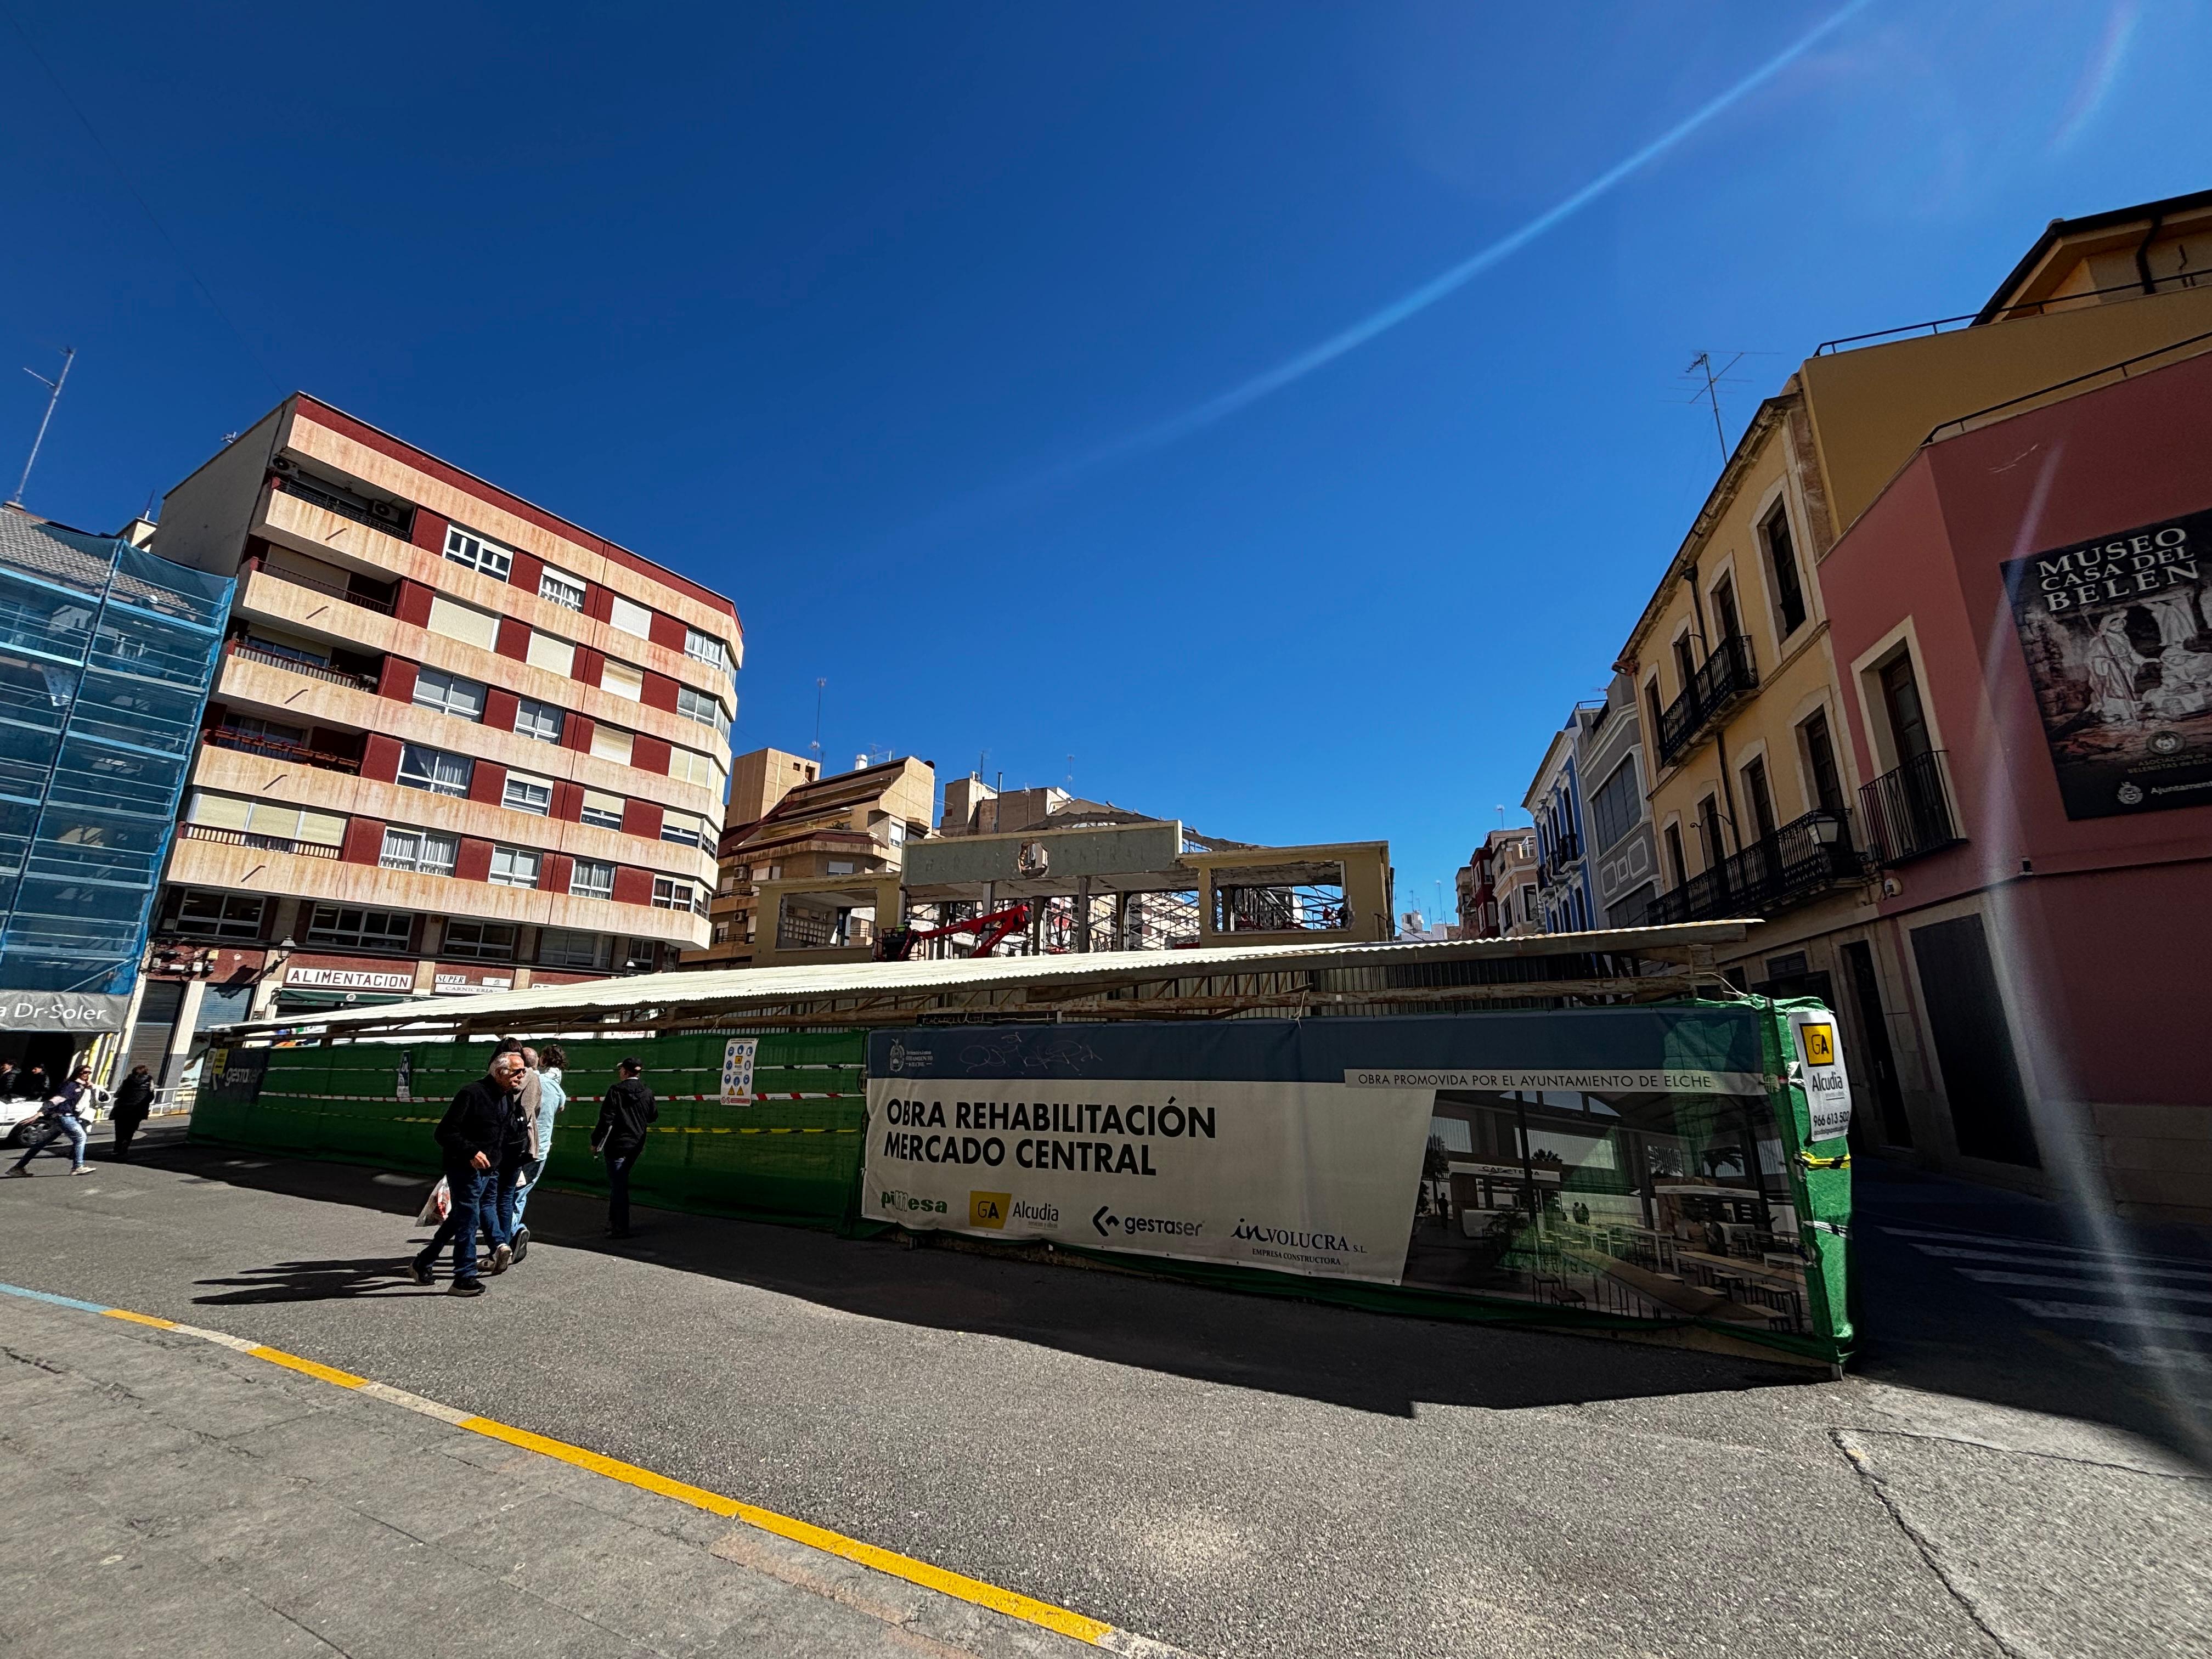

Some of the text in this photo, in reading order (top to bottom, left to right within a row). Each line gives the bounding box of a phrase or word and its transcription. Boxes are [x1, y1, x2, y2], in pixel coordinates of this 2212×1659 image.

[2036, 528, 2186, 578] MUSEO
[2041, 546, 2194, 590] CASA DEL
[2042, 560, 2199, 612] BELÉN
[290, 970, 409, 988] ALIMENTACION
[438, 975, 464, 984] SUPER
[1358, 1074, 1712, 1087] OBRA PROMOVIDA POR EL AYUNTAMIENTO DE ELCHE
[1812, 1071, 1843, 1092] Alcudia
[887, 1096, 1216, 1138] OBRA REHABILITACIÓN
[1813, 1110, 1849, 1127] 966 613 502
[884, 1132, 1156, 1176] MERCADO CENTRAL
[881, 1190, 947, 1214] pimesa
[1013, 1201, 1059, 1222] Alcudia
[1252, 1248, 1341, 1265] EMPRESA CONSTRUCTORA
